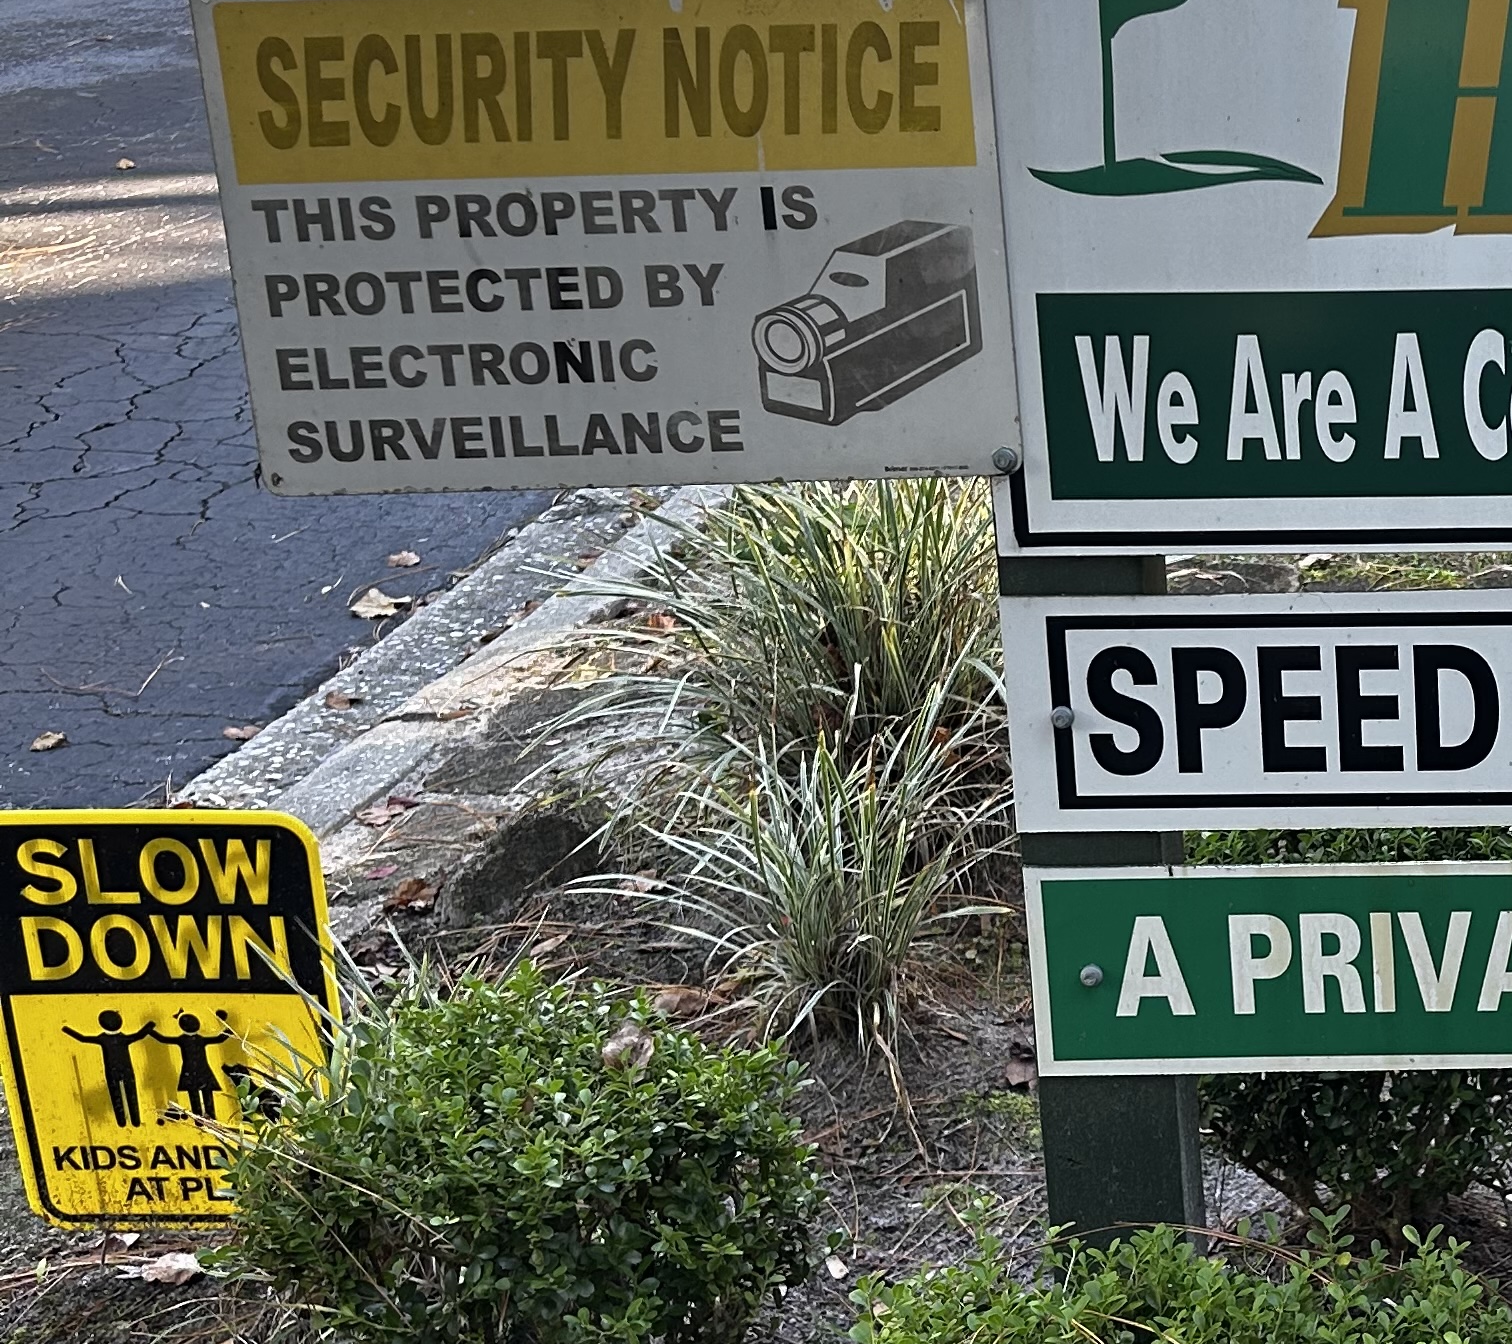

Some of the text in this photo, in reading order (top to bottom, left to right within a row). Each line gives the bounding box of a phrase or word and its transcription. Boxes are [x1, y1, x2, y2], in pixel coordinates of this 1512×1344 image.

[256, 21, 941, 150] SECURITY NOTICE
[251, 186, 818, 243] THIS PROPERTY IS
[264, 263, 724, 317] PROTECTED BY
[275, 339, 659, 391] ELECTRONIC
[1075, 335, 1199, 464] We
[1226, 334, 1357, 462] Are
[1383, 332, 1440, 459] A
[287, 410, 744, 464] SURVEILLANCE
[1086, 644, 1500, 776] SPEED
[17, 837, 271, 905] SLOW
[20, 914, 297, 981] DOWN
[1115, 915, 1196, 1017] A
[53, 1145, 229, 1171] KIDS AND
[126, 1177, 170, 1201] AT
